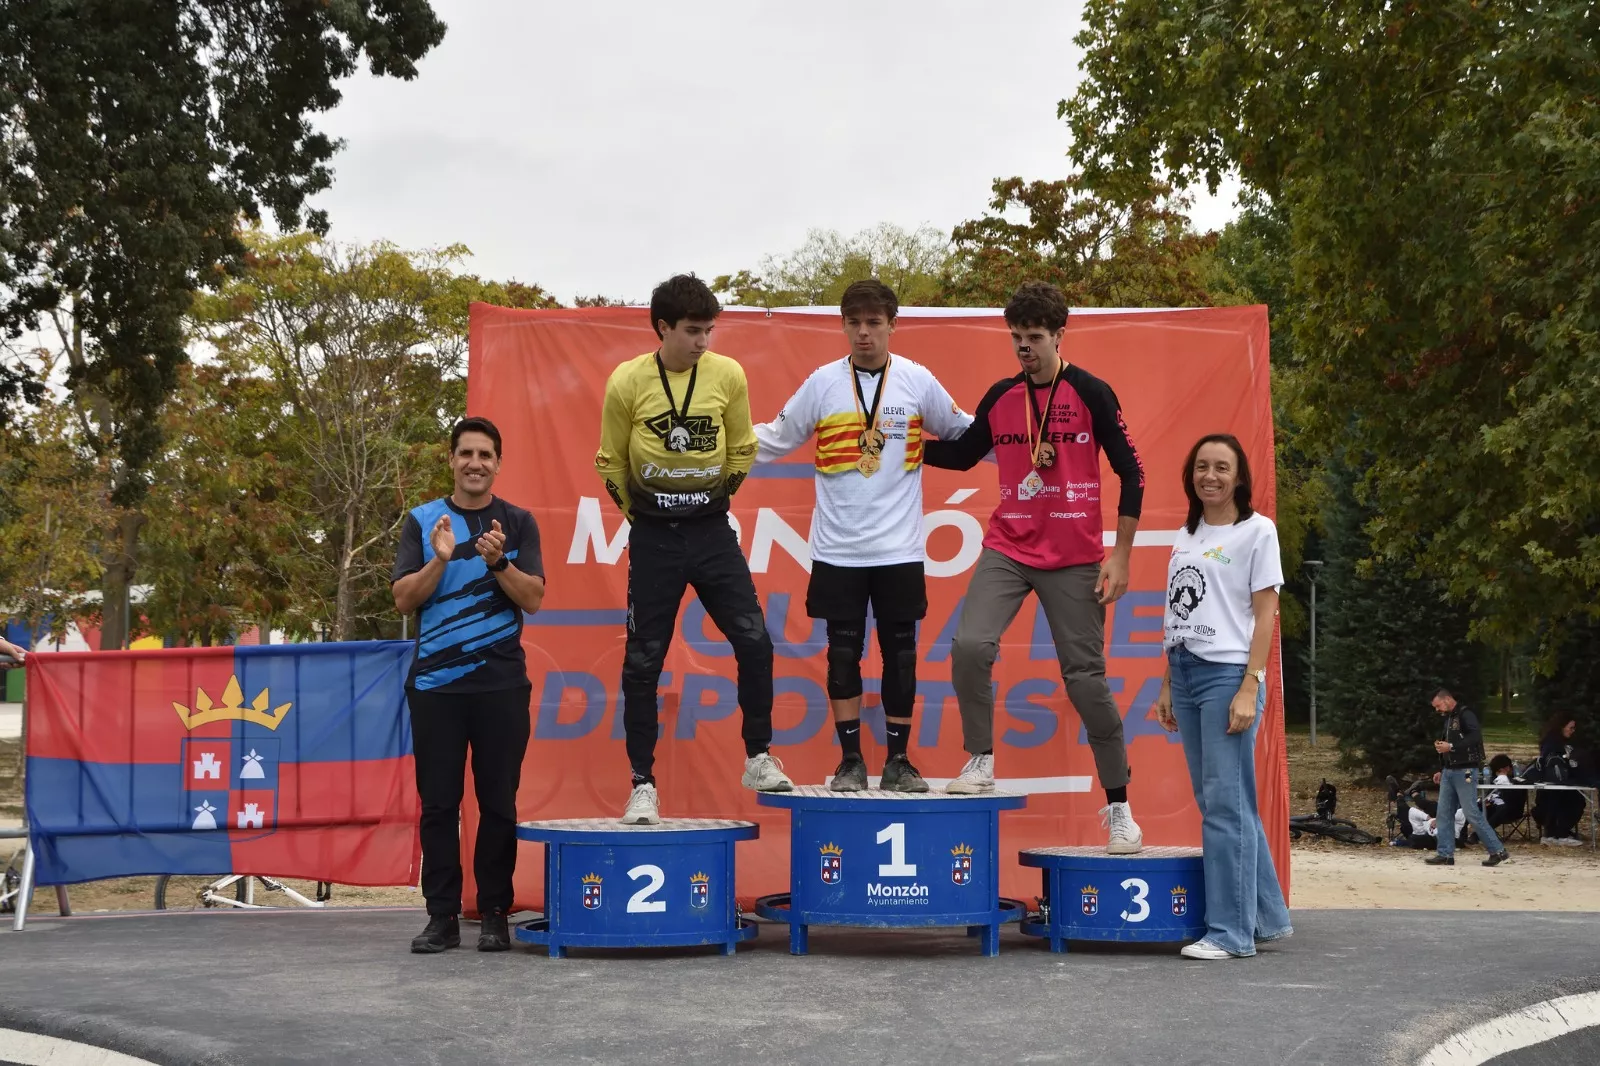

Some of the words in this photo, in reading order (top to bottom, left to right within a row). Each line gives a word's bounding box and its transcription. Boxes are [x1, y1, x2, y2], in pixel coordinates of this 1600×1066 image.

[876, 822, 916, 876] 1
[626, 864, 666, 913] 2
[867, 883, 929, 897] Monzón
[867, 897, 929, 906] Ayuntamiento
[1120, 878, 1150, 922] 3
